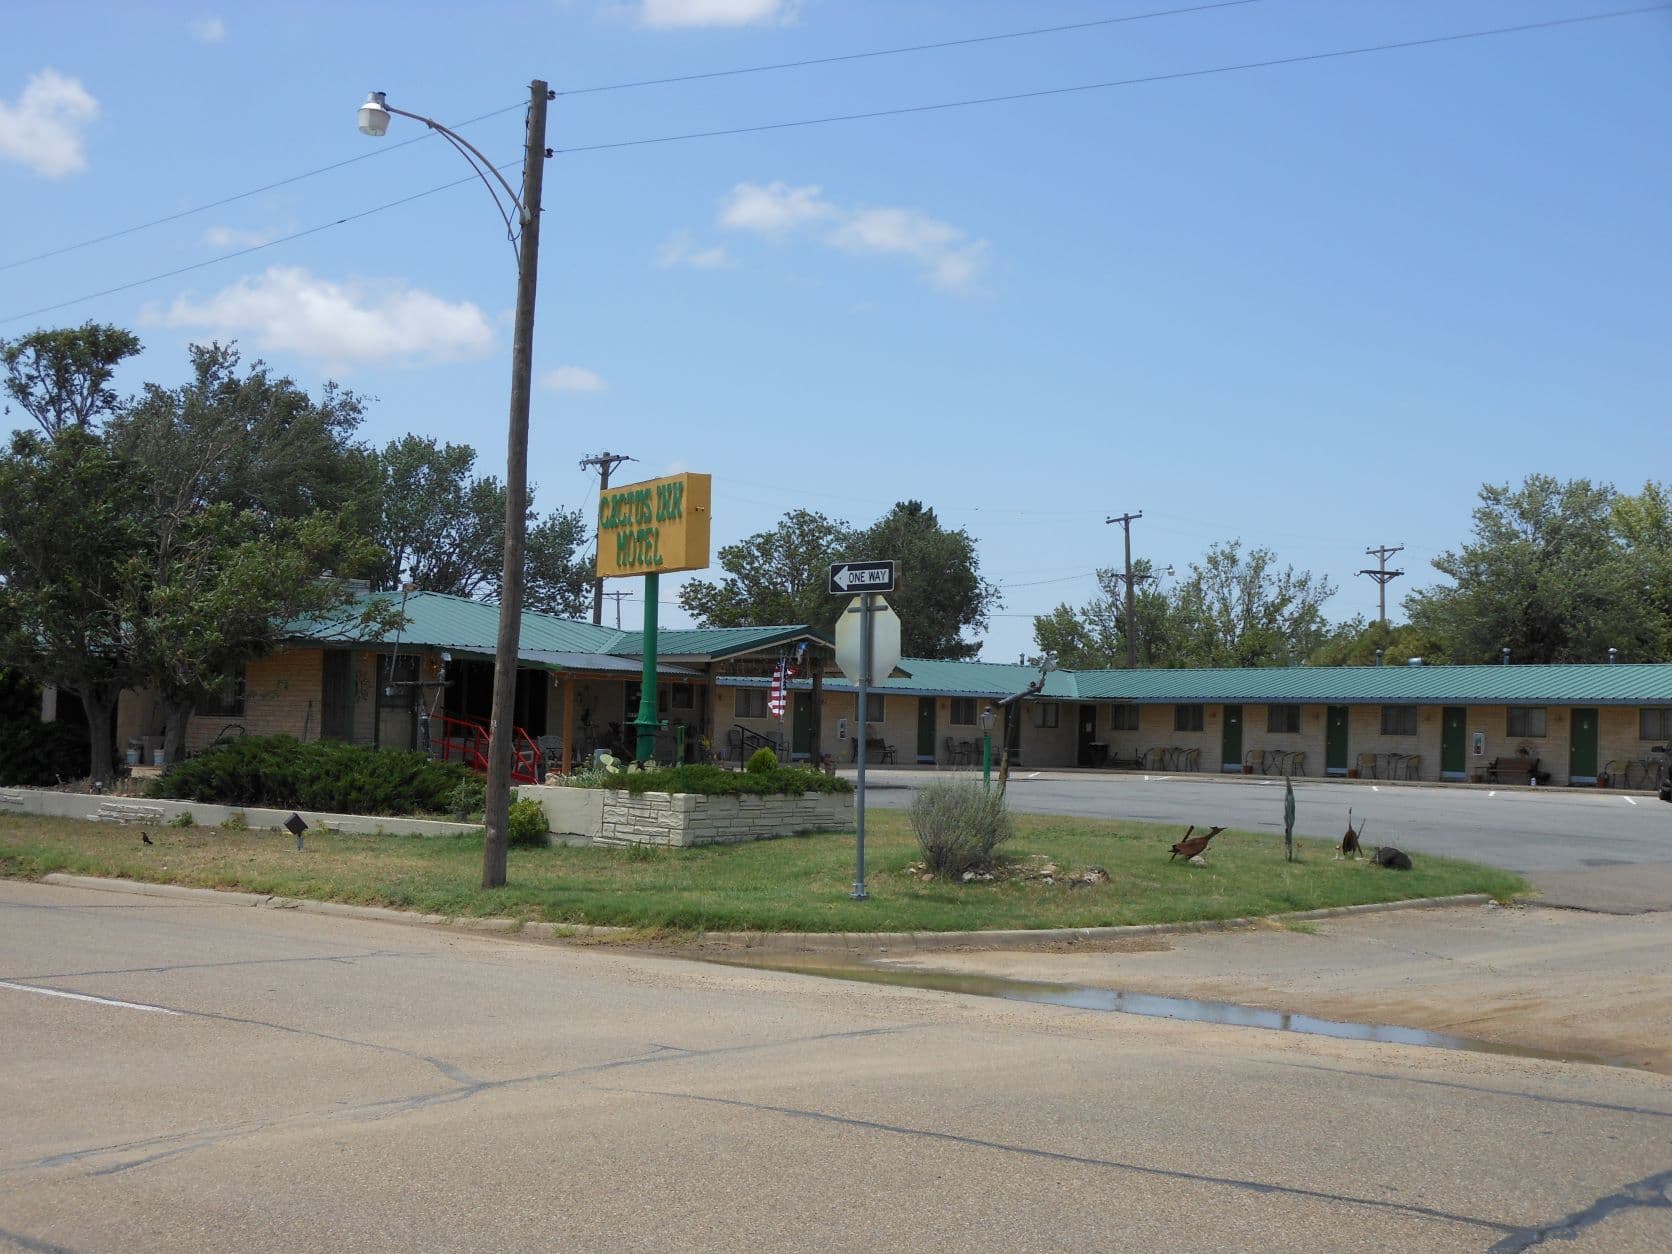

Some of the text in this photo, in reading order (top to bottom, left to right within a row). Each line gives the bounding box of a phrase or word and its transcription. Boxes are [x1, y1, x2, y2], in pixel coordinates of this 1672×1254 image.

[601, 481, 684, 528] CACTUS INN
[616, 527, 663, 567] MOTEL
[848, 570, 887, 584] ONE WAY
